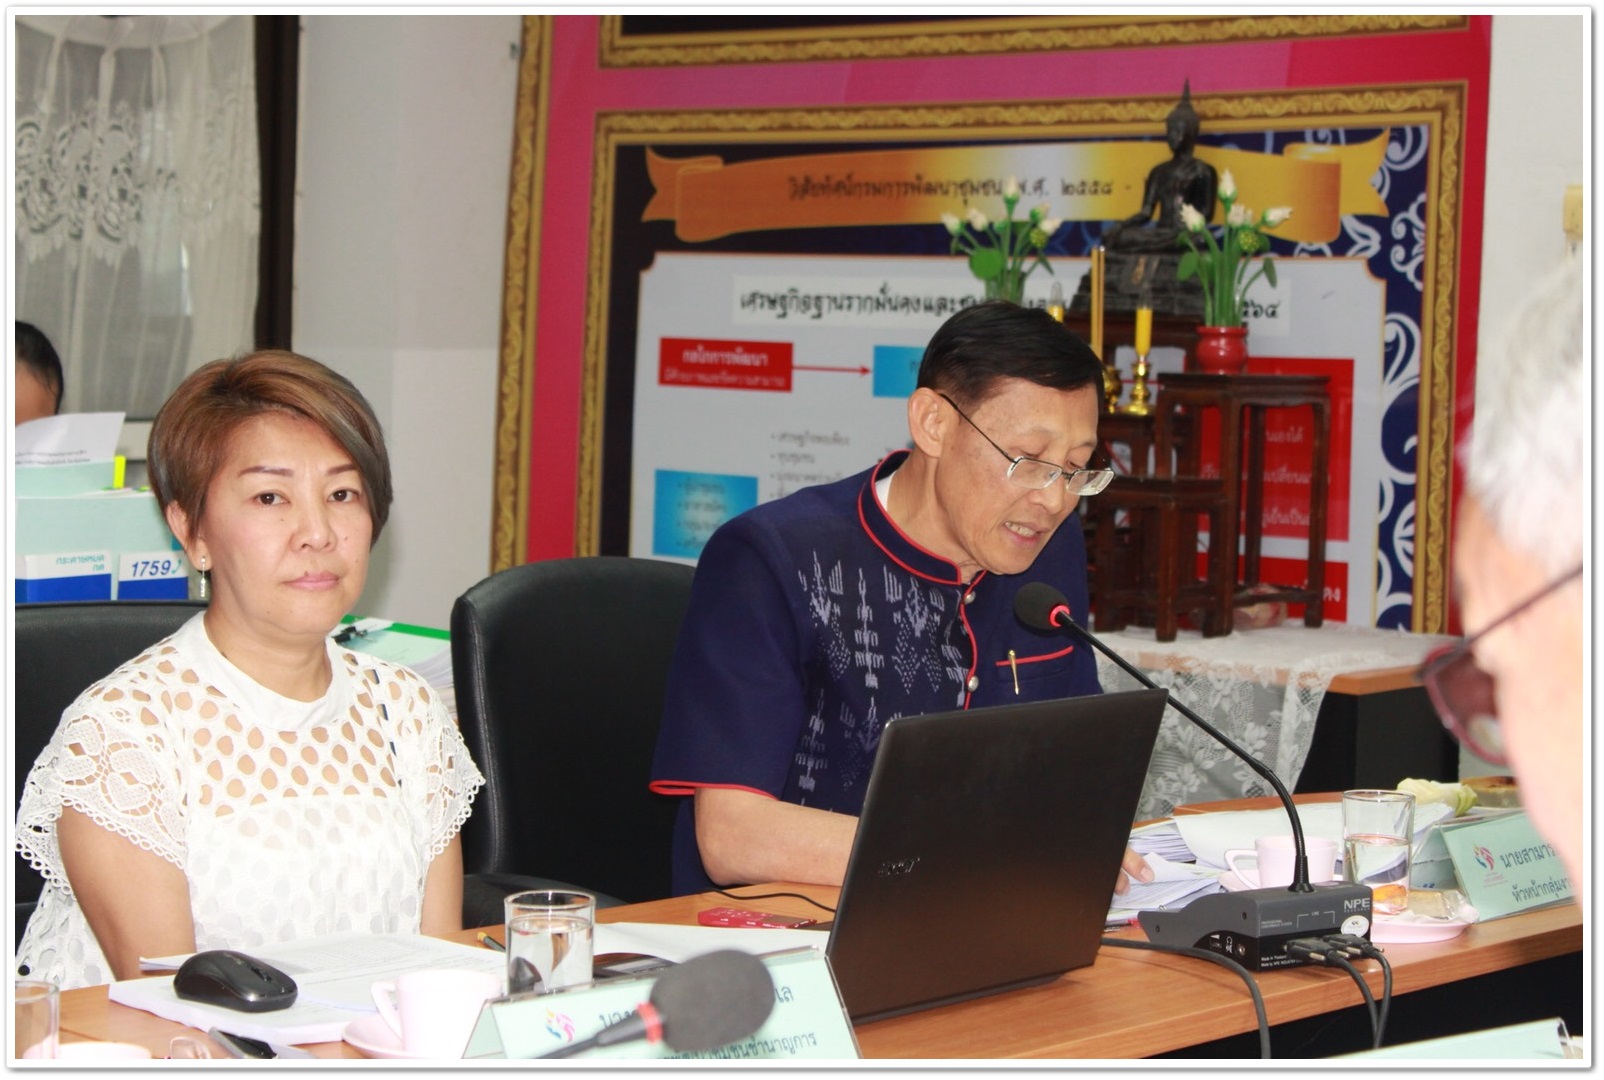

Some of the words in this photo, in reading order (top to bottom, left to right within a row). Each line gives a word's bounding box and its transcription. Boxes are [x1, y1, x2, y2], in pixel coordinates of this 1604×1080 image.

[131, 559, 172, 578] 1759
[1500, 843, 1559, 869] นายสามาร
[1512, 876, 1574, 902] หัวหน้ากลุ่มงา
[1344, 898, 1371, 910] NPE
